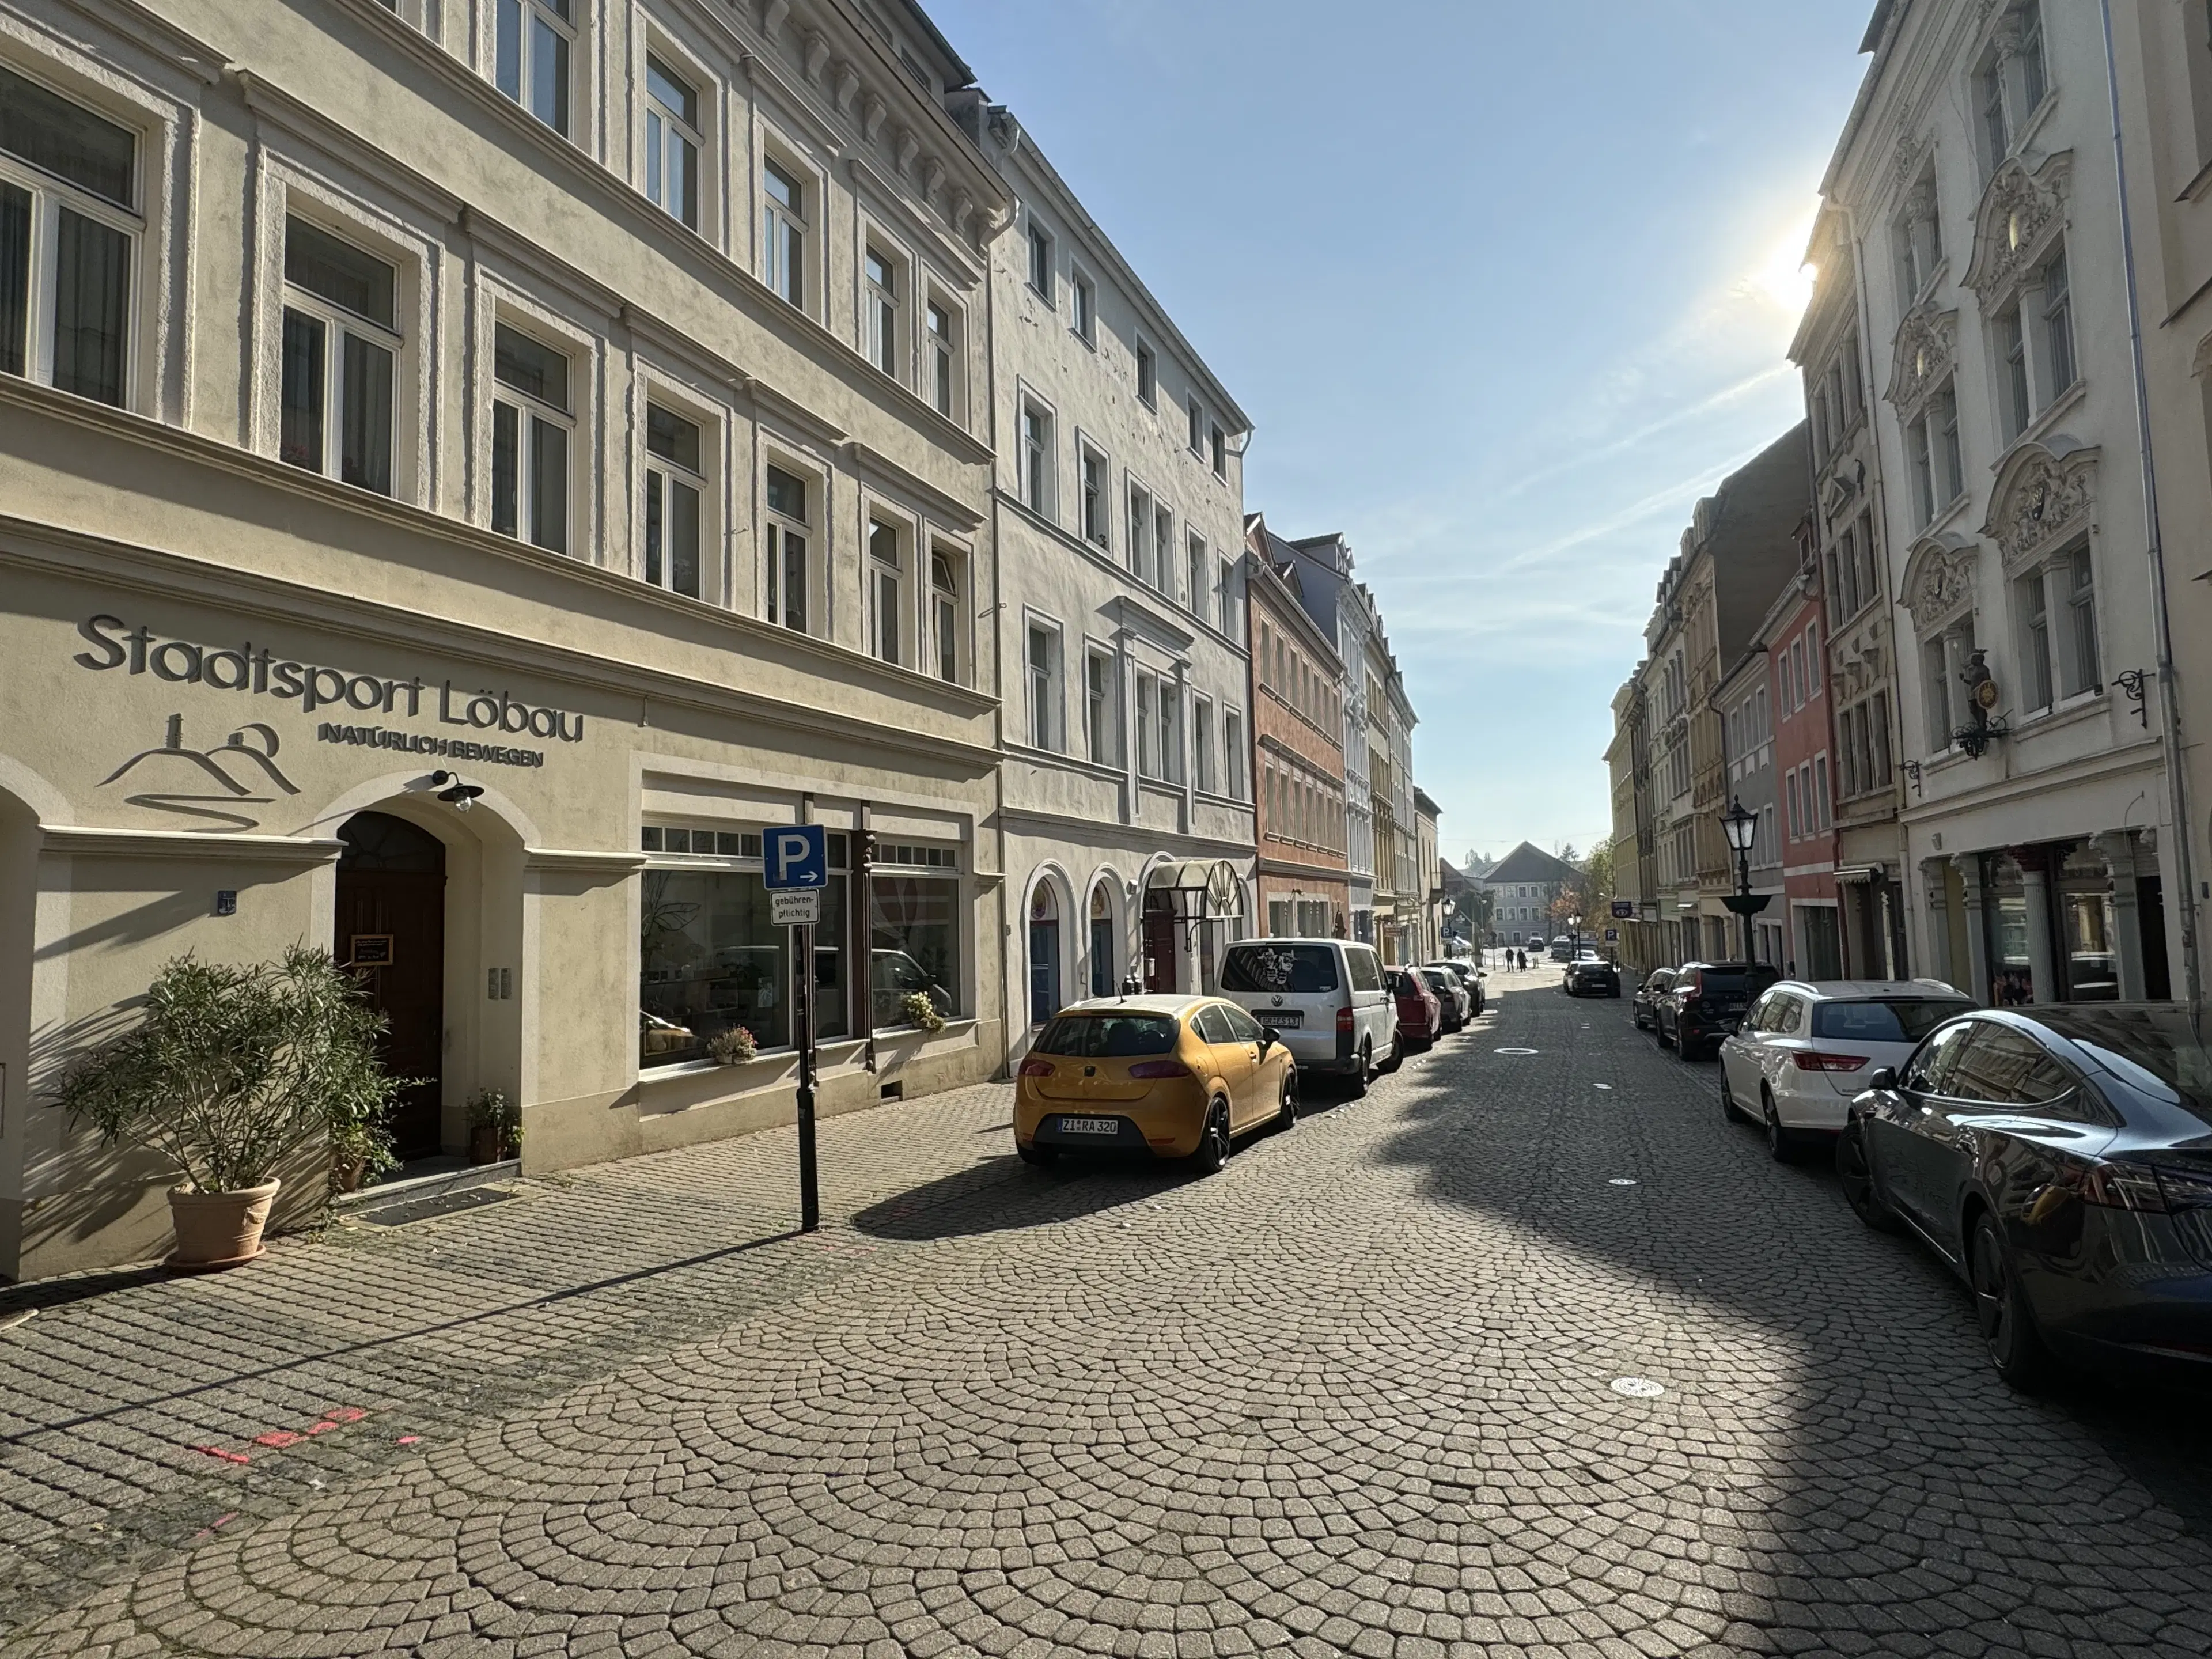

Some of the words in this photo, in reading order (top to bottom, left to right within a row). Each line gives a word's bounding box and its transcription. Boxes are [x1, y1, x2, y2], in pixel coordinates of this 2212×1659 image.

[73, 613, 425, 717] Stadtsport
[439, 679, 584, 743] Löbau
[317, 722, 449, 756] NATÜRLICH
[447, 740, 544, 768] BEWEGEN
[778, 834, 810, 881] P
[775, 895, 814, 907] gebühren-
[778, 908, 810, 919] pflichtig
[1443, 927, 1449, 937] P
[1607, 930, 1615, 940] P
[1097, 1121, 1116, 1132] 320
